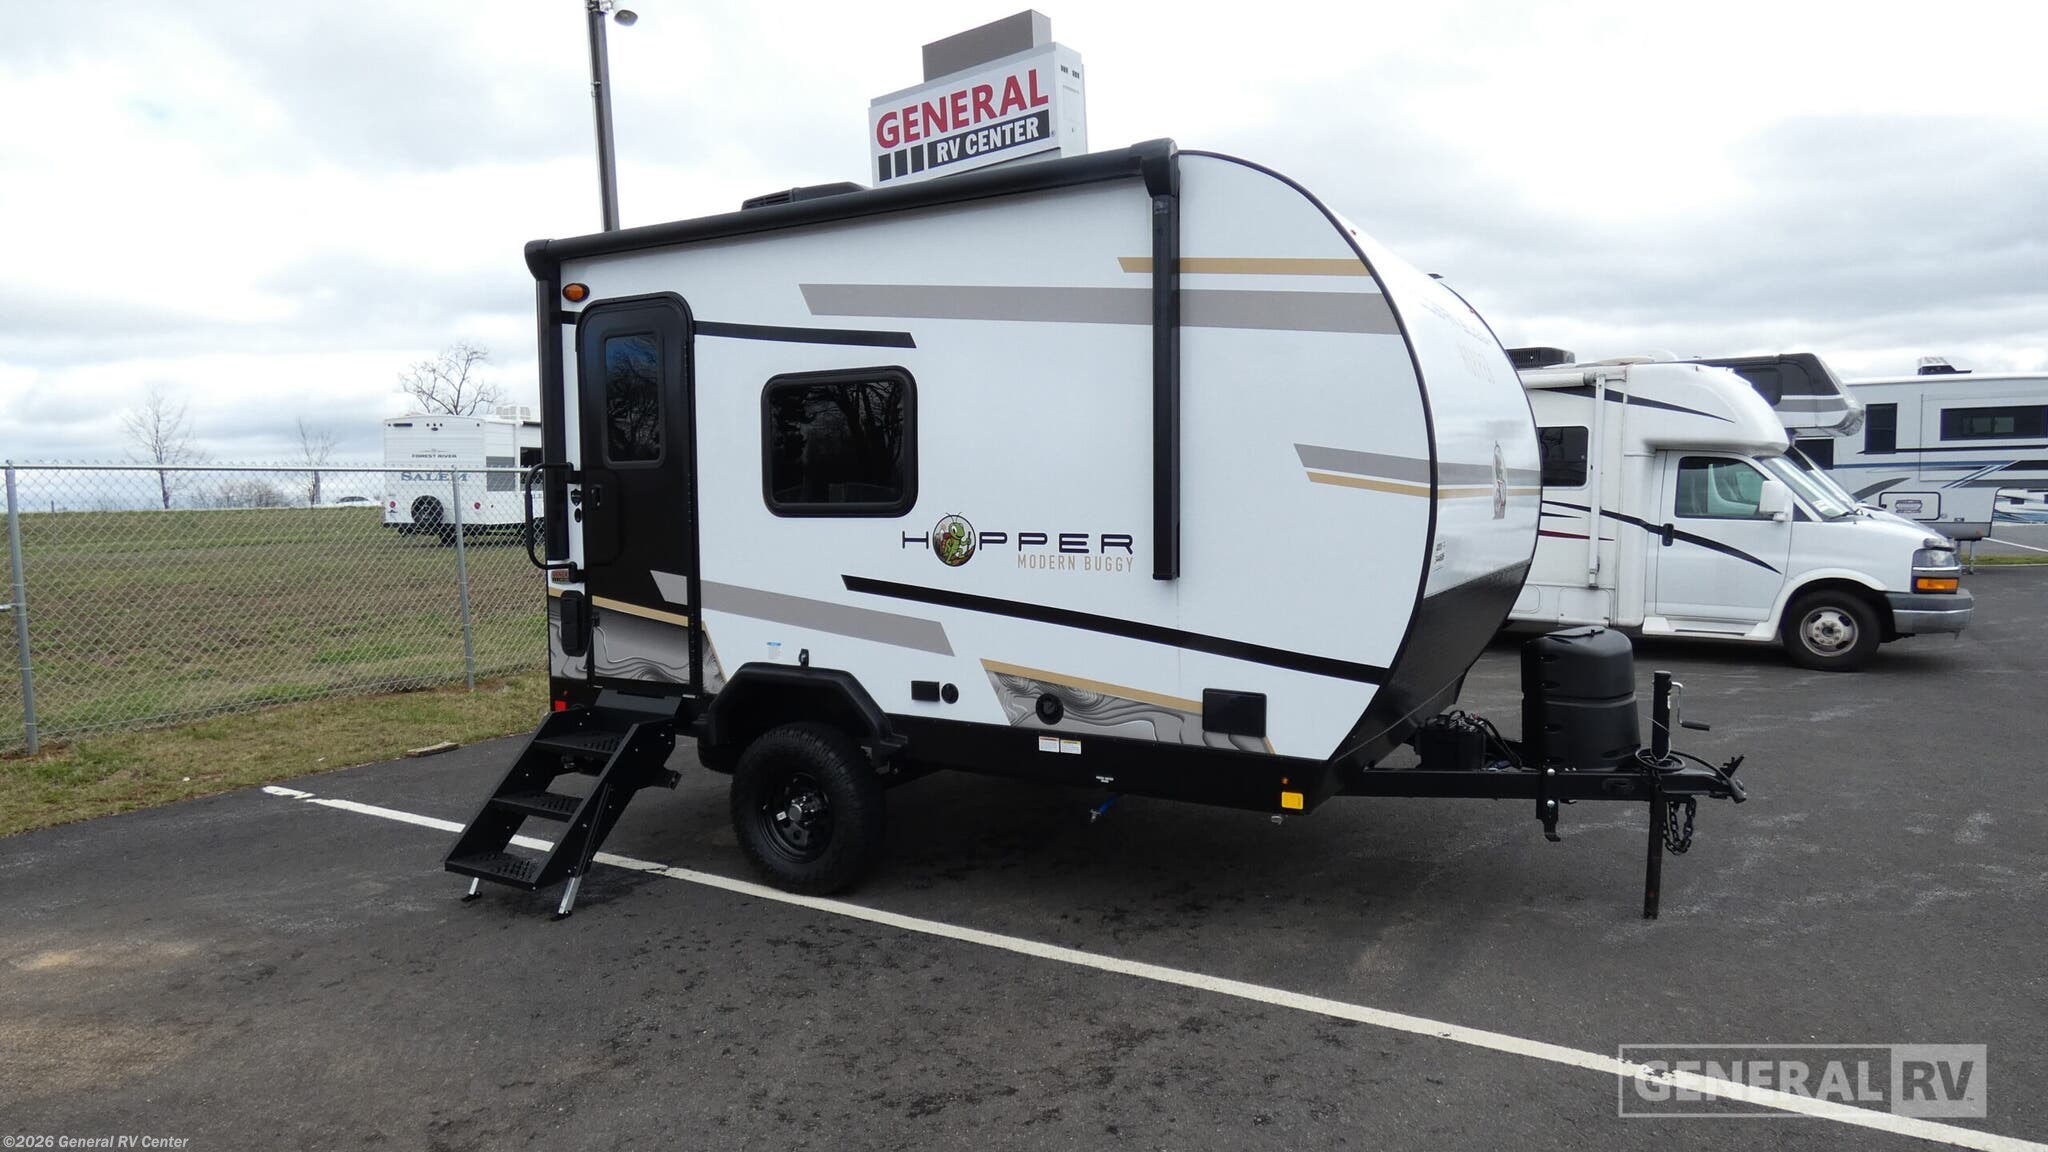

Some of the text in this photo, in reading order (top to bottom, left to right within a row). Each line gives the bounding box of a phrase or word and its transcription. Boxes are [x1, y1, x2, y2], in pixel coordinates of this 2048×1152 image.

[876, 69, 1049, 149] GENERAL
[937, 117, 1039, 163] RV CENTER
[401, 471, 469, 481] SALEM
[1017, 554, 1134, 573] MODERN BUGGY
